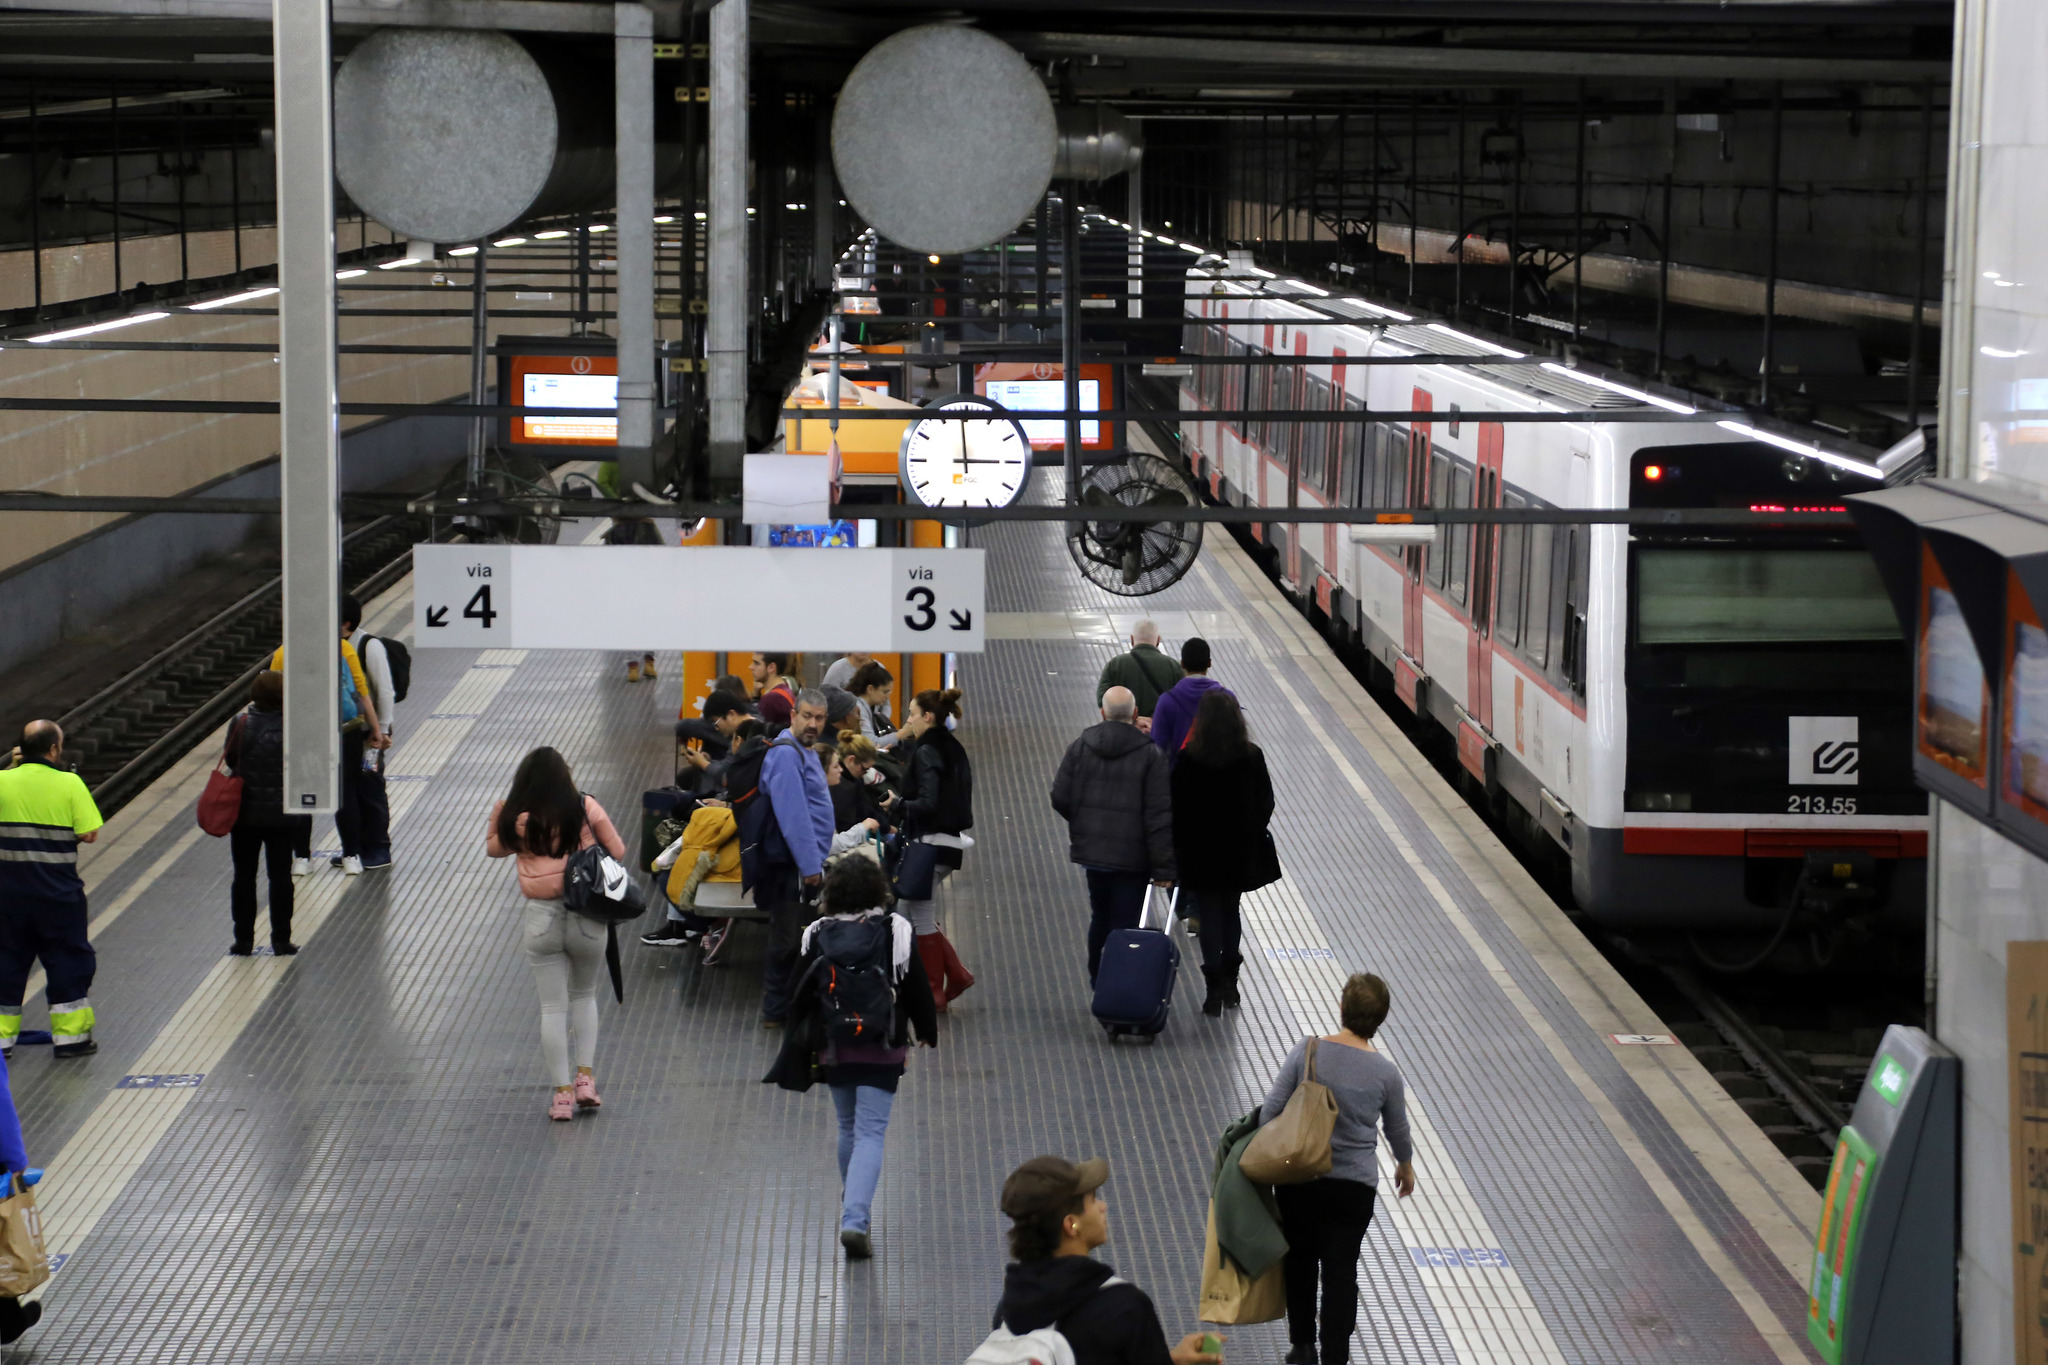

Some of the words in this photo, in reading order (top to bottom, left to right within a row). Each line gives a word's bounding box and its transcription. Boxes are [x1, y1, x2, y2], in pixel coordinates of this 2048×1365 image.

[991, 391, 999, 400] 3
[466, 563, 492, 577] via
[908, 566, 933, 580] via
[463, 584, 497, 628] 4
[904, 586, 937, 632] 3
[1787, 795, 1857, 815] 213.55
